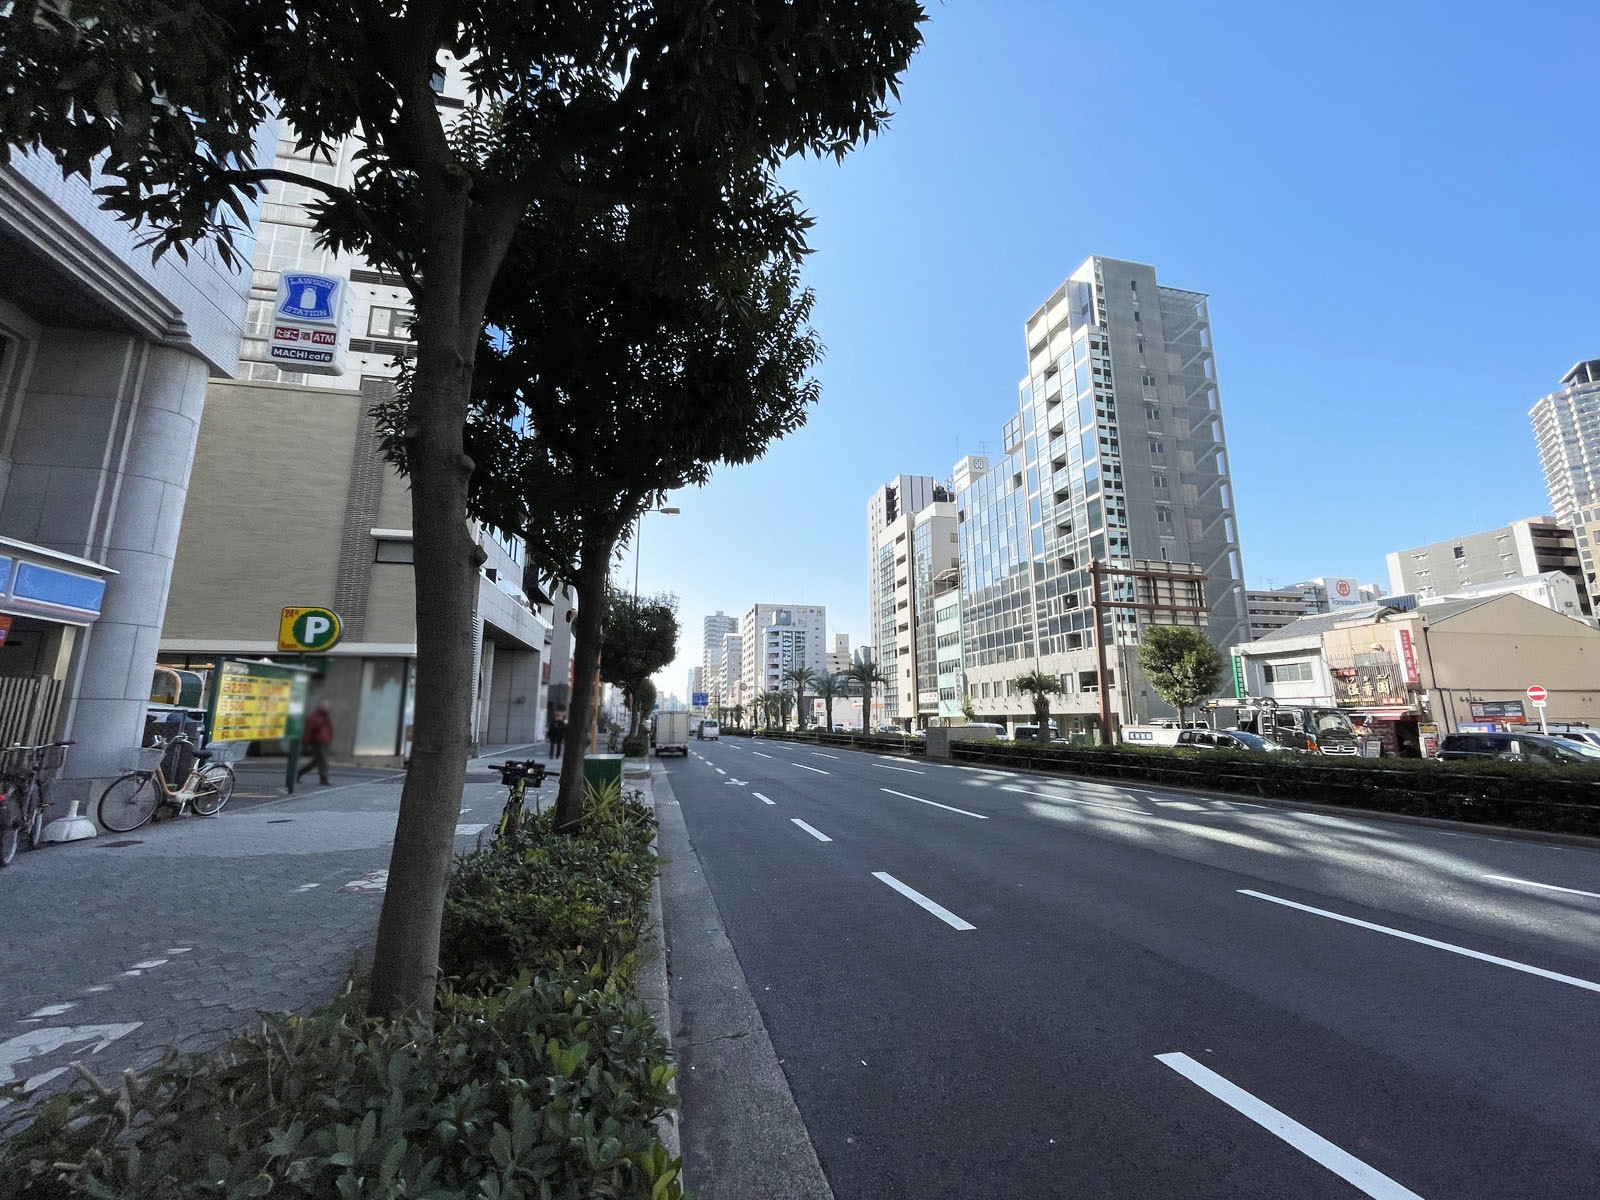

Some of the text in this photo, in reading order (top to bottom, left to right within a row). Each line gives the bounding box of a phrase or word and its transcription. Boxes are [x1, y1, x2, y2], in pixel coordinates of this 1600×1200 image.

[290, 278, 333, 290] LAWSON
[284, 305, 328, 317] STATION
[275, 328, 299, 340] たばこ
[313, 332, 335, 344] ATM
[273, 348, 331, 361] MACHI café
[304, 616, 330, 644] P
